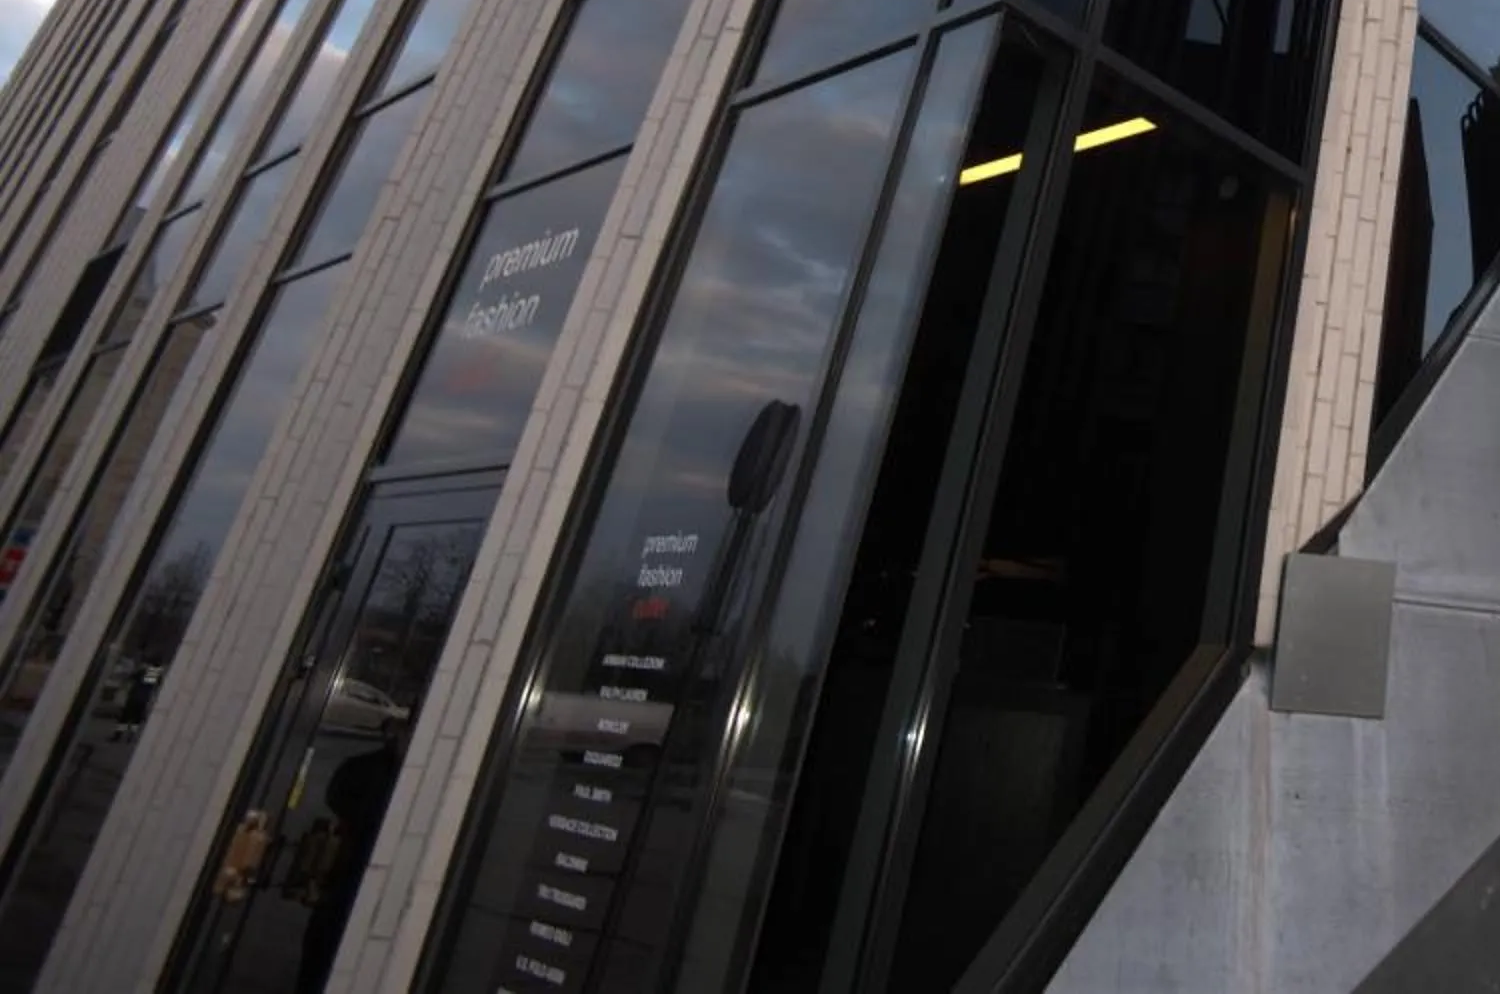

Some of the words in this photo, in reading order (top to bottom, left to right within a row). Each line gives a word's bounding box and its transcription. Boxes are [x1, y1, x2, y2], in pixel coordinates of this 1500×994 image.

[478, 227, 580, 293] premium
[463, 291, 541, 339] fashion
[641, 530, 699, 559] premium
[637, 563, 683, 588] fashion
